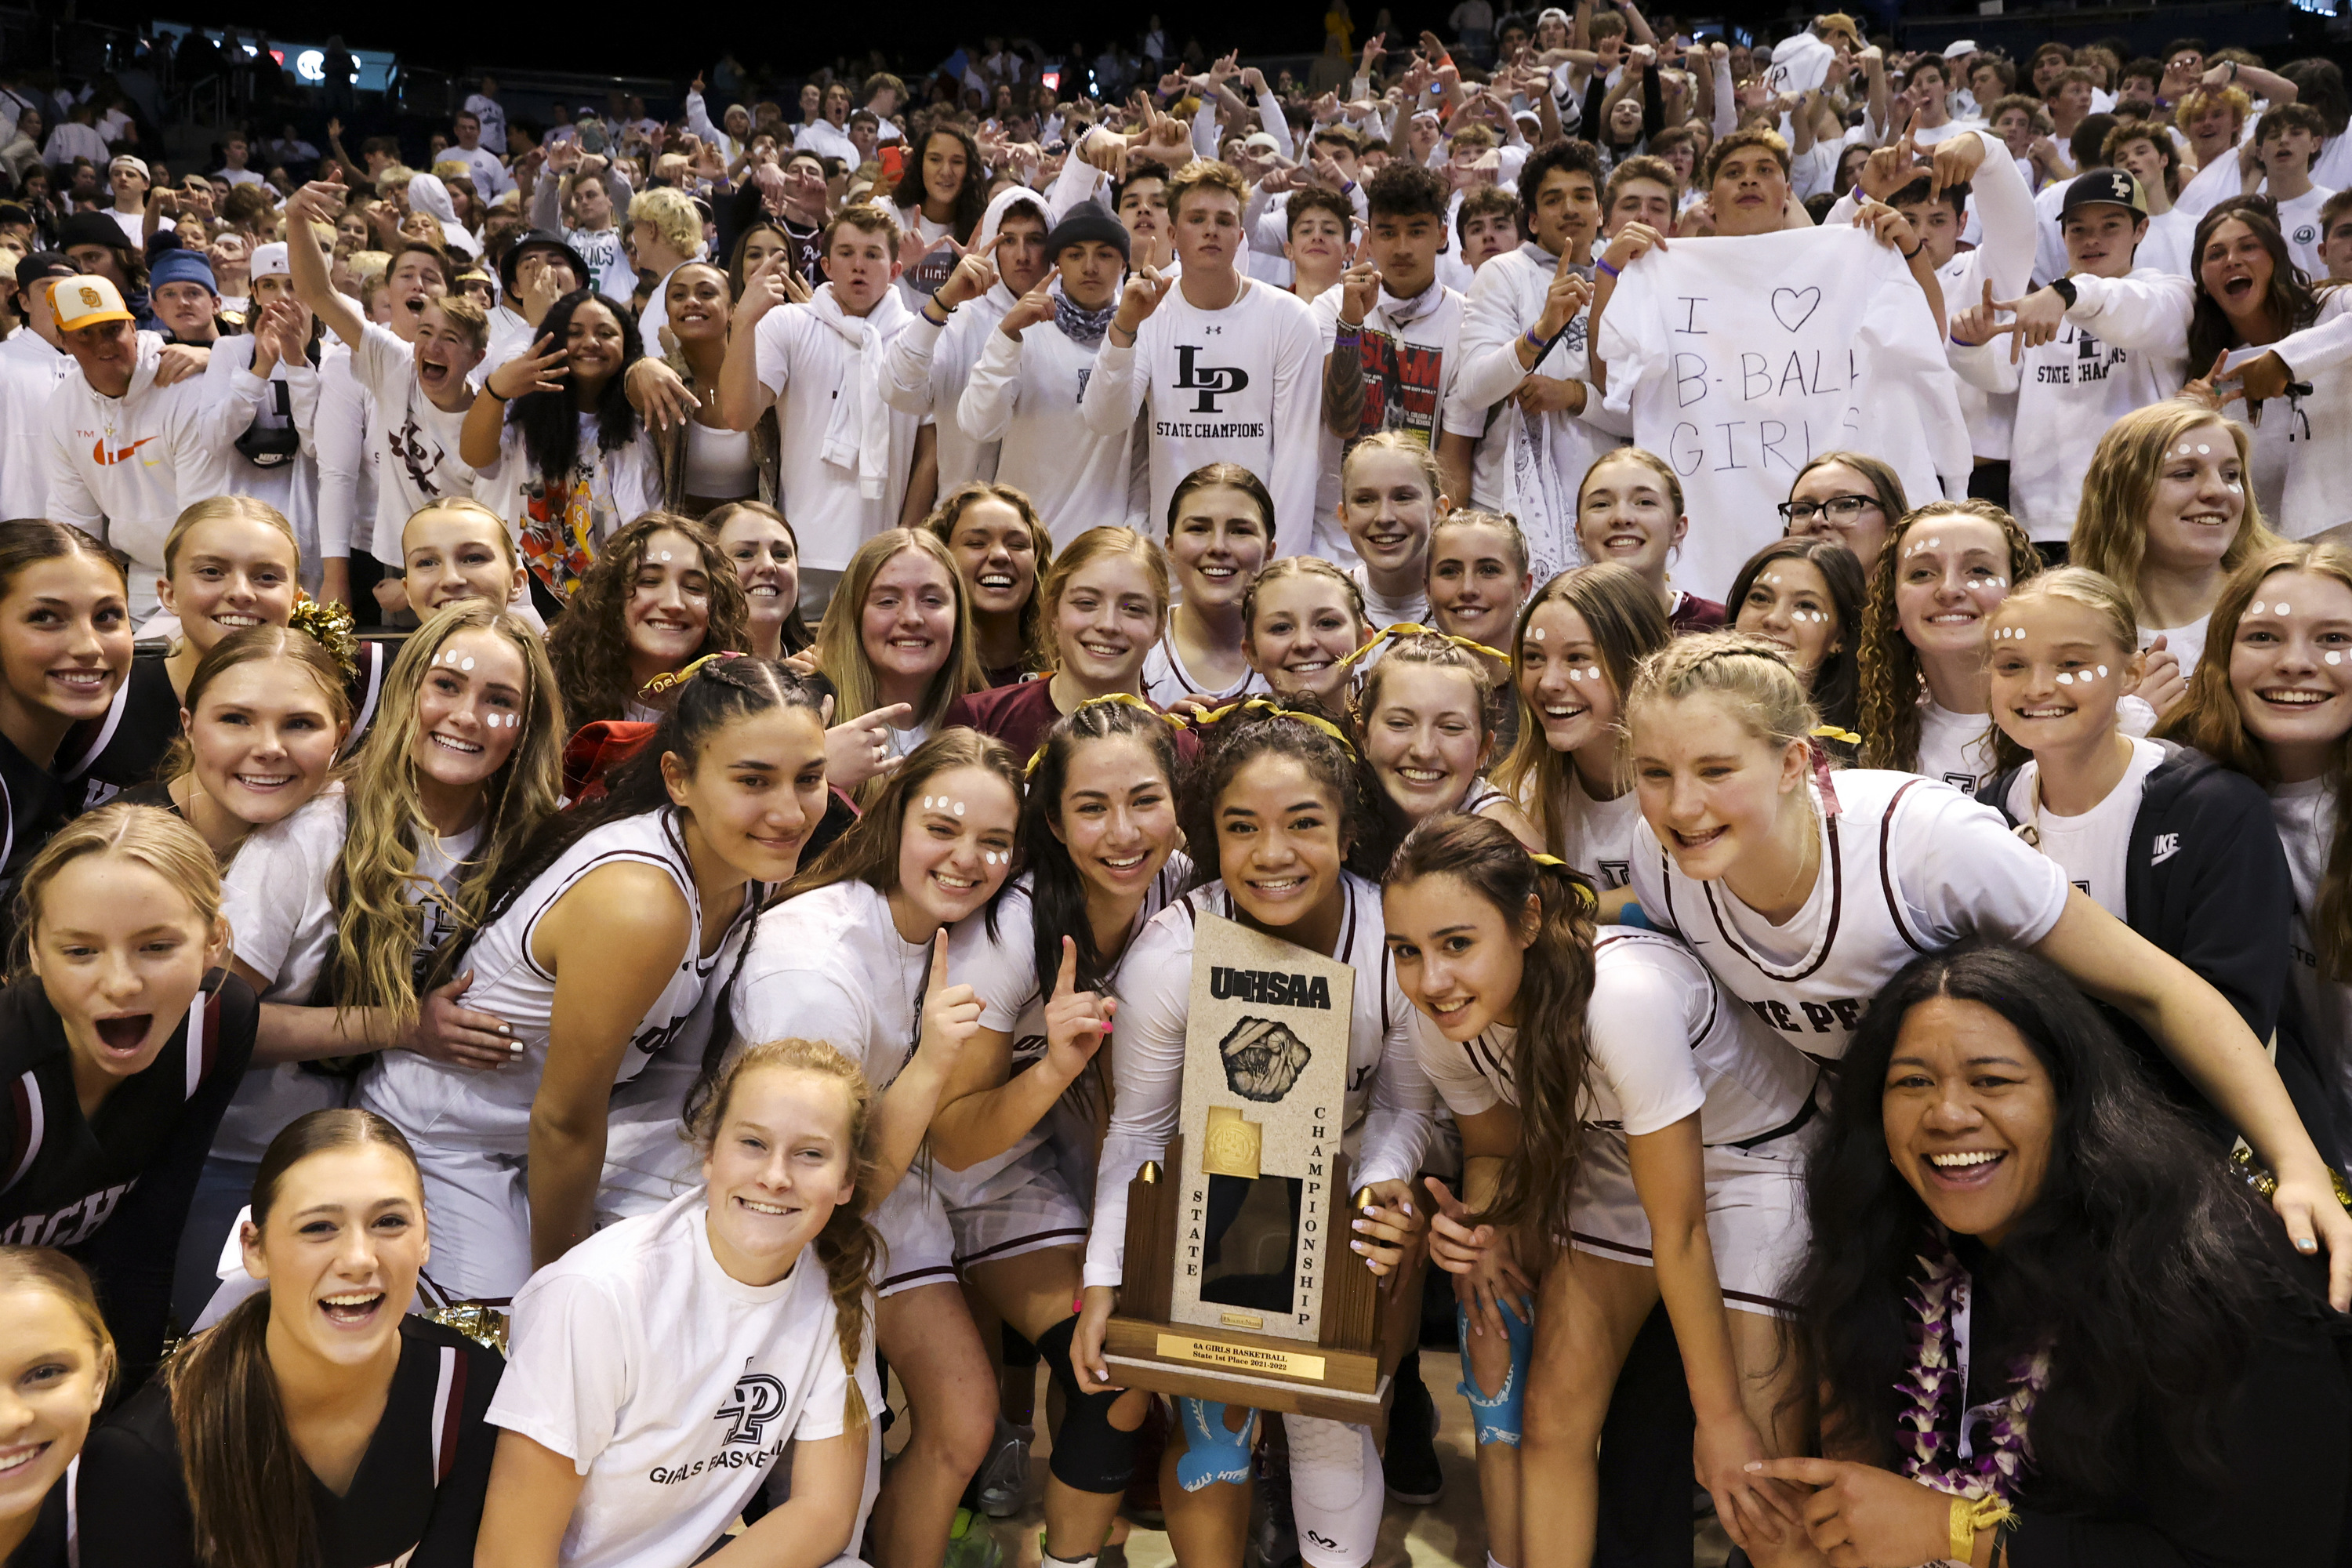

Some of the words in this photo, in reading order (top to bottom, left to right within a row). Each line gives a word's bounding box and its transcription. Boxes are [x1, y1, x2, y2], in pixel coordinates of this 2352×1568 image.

[2111, 173, 2131, 198] LP
[1675, 297, 1708, 334] I
[1172, 345, 1249, 413] LP
[2037, 365, 2071, 384] STATE
[1156, 422, 1192, 437] STATE
[1195, 423, 1264, 438] CHAMPIONS
[2153, 833, 2180, 855] IKE
[1744, 1000, 1803, 1033] NE
[1298, 1107, 1326, 1325] CHAMPIONSHIP
[1186, 1191, 1203, 1276] STATE
[1192, 1350, 1213, 1359] State
[1228, 1356, 1249, 1364] Place
[1250, 1359, 1287, 1370] 2021-2022
[1205, 1344, 1231, 1354] GIRLS
[1232, 1348, 1287, 1362] BASKETBALL
[649, 1460, 704, 1484] GIRLS
